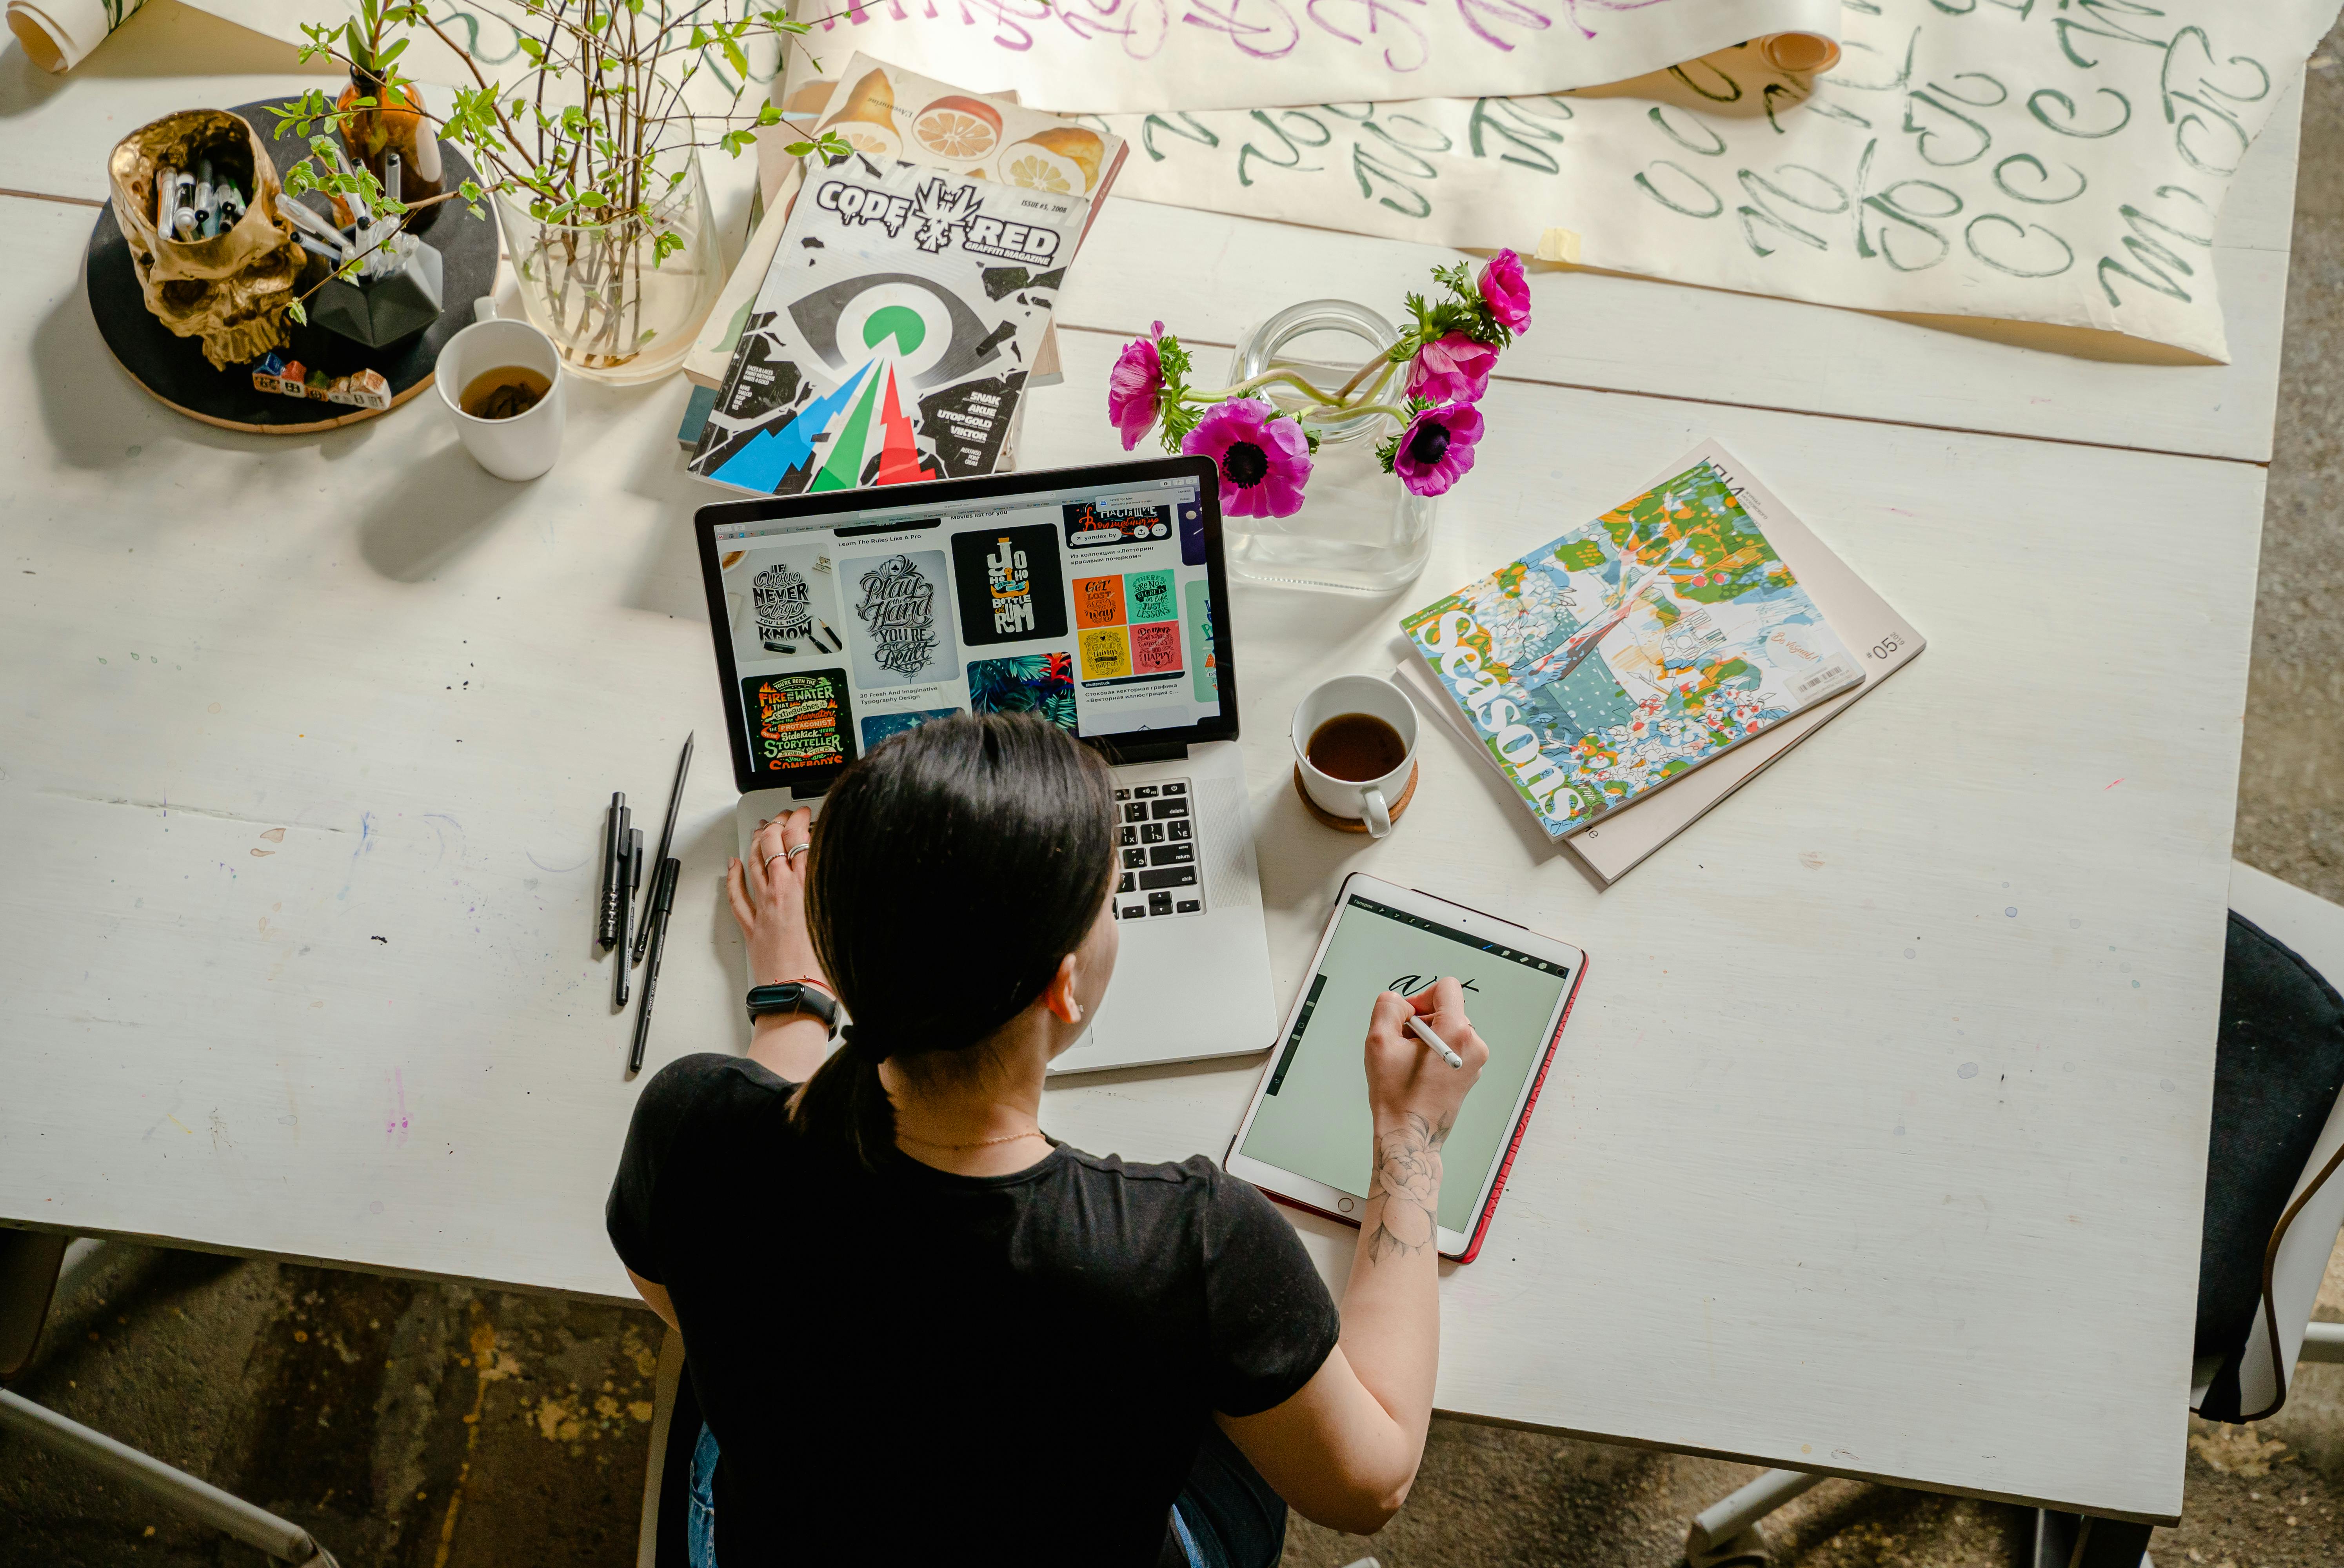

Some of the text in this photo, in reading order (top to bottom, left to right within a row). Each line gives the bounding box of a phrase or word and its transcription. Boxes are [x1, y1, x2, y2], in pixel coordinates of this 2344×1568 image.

[1021, 200, 1038, 208] ISSUE
[818, 181, 1059, 257] CODE RED
[965, 241, 1050, 265] GRAFFITI MAGAZINE
[970, 391, 1001, 405] SNAK
[968, 404, 997, 417] AKUE
[937, 409, 992, 428] UTOP GOLD
[950, 425, 987, 441] VIKTOR
[1746, 491, 1761, 506] ЖУРНАЛ
[1741, 494, 1768, 520] МОСКОВСКОГО
[1084, 533, 1116, 542] yandex.by
[772, 564, 785, 573] IF
[1136, 575, 1160, 583] THERE
[752, 583, 810, 608] NEVER
[856, 576, 933, 608] Play
[1087, 591, 1111, 600] LOST
[1137, 588, 1165, 599] REGRETS
[992, 594, 1032, 608] BOTTLE
[1141, 602, 1161, 610] JUST
[859, 592, 934, 630] Hand
[1136, 606, 1170, 618] LESSONS
[786, 614, 807, 625] NEVER
[994, 602, 1035, 634] RUM
[758, 619, 812, 641] KNOW
[1889, 632, 1906, 648] 2019
[1092, 642, 1116, 651] GOOD
[1092, 649, 1118, 658] things
[1143, 651, 1171, 662] HAPPY
[1095, 661, 1119, 670] happen
[775, 679, 791, 689] YOU'RE
[795, 686, 834, 701] WATER
[902, 686, 938, 695] Imaginative
[1125, 691, 1168, 699] иллюстрация
[759, 692, 787, 706] FIRE
[860, 697, 897, 705] Typography
[772, 702, 789, 711] THAT
[774, 703, 819, 719] Extinguishes
[1416, 610, 1586, 821] Seasons
[781, 719, 832, 731] PROTAGONIST
[781, 730, 822, 741] Sidekick.
[764, 734, 844, 758] STORYTELLER
[1354, 899, 1373, 909] Галерея
